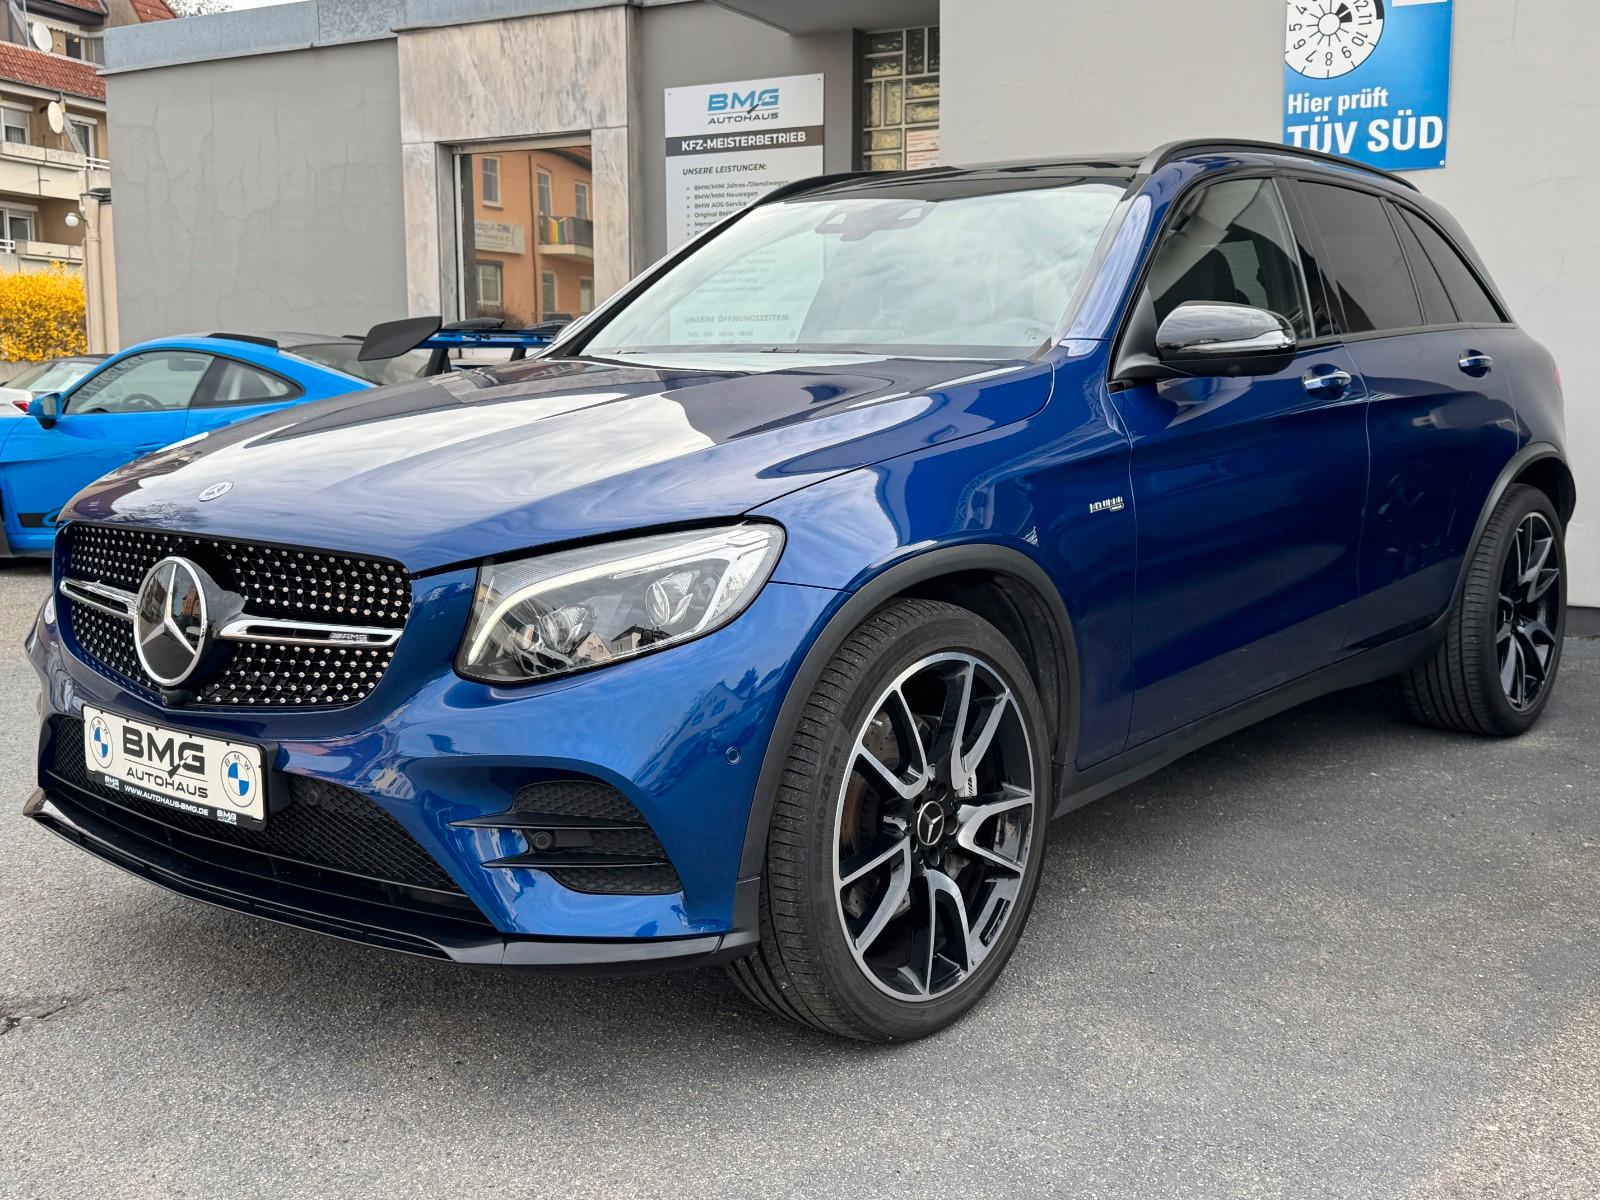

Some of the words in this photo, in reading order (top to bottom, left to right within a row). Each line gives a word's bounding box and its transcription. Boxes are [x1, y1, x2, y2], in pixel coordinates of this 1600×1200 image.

[1289, 23, 1302, 31] 5
[1358, 13, 1372, 26] 11
[1351, 32, 1368, 46] 10
[1325, 51, 1333, 66] 8
[707, 88, 780, 112] BMG
[1287, 93, 1332, 114] Hier
[1337, 87, 1389, 116] prüft
[707, 112, 779, 125] AUTOHAUS
[681, 131, 807, 151] KFZ-MEISTERBETRIEB
[1287, 115, 1358, 154] TÜV
[1367, 109, 1443, 152] SÜD
[682, 166, 714, 176] UNSERE
[715, 163, 767, 174] LEISTUNGEN:
[122, 724, 205, 776] BMG
[126, 766, 209, 799] AUTOHAUS
[124, 785, 209, 816] WWW.AUTOHAUS-BMG.DE
